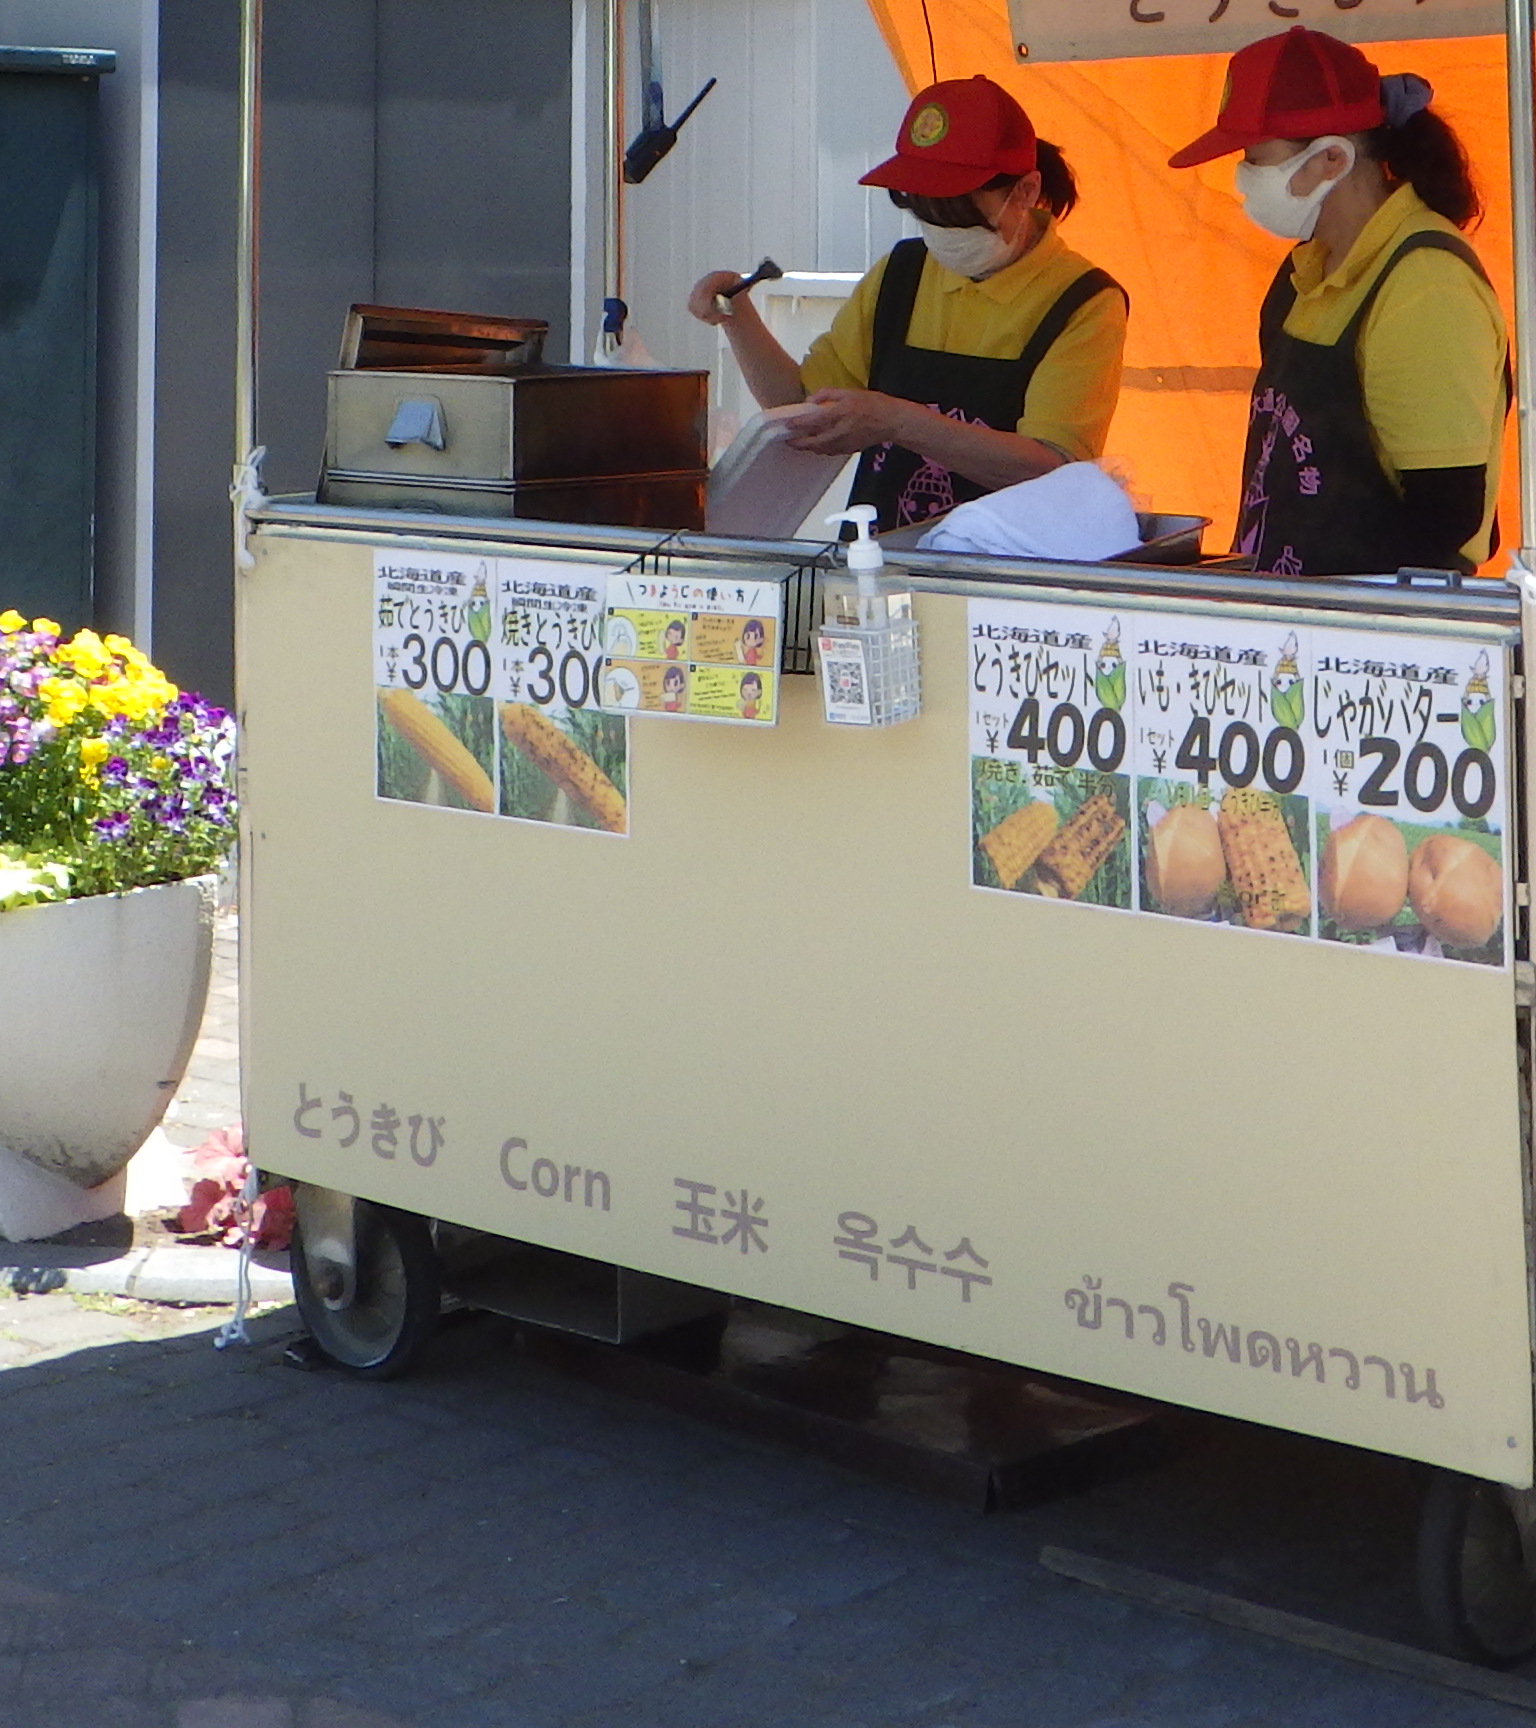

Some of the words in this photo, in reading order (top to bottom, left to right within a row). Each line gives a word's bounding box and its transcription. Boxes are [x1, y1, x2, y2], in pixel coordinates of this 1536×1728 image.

[378, 565, 468, 587] 北海道産
[501, 579, 598, 602] 北海道産
[638, 583, 745, 604] つまようじの使い方
[378, 594, 468, 635] 茹でとうきび
[501, 607, 598, 651] 焼きとうきび
[972, 623, 1093, 651] 北海道産
[1138, 639, 1269, 668] 北海道産
[974, 643, 1094, 707] とうきびセット
[1317, 656, 1459, 686] 北海道産
[1313, 674, 1460, 744] じゃがバター
[292, 1081, 447, 1168] とうきび
[499, 1137, 611, 1212] Corn
[671, 1176, 769, 1256] 玉米
[832, 1210, 994, 1304] 옥수수
[1064, 1274, 1445, 1410] ข้าวโพดหวาน
